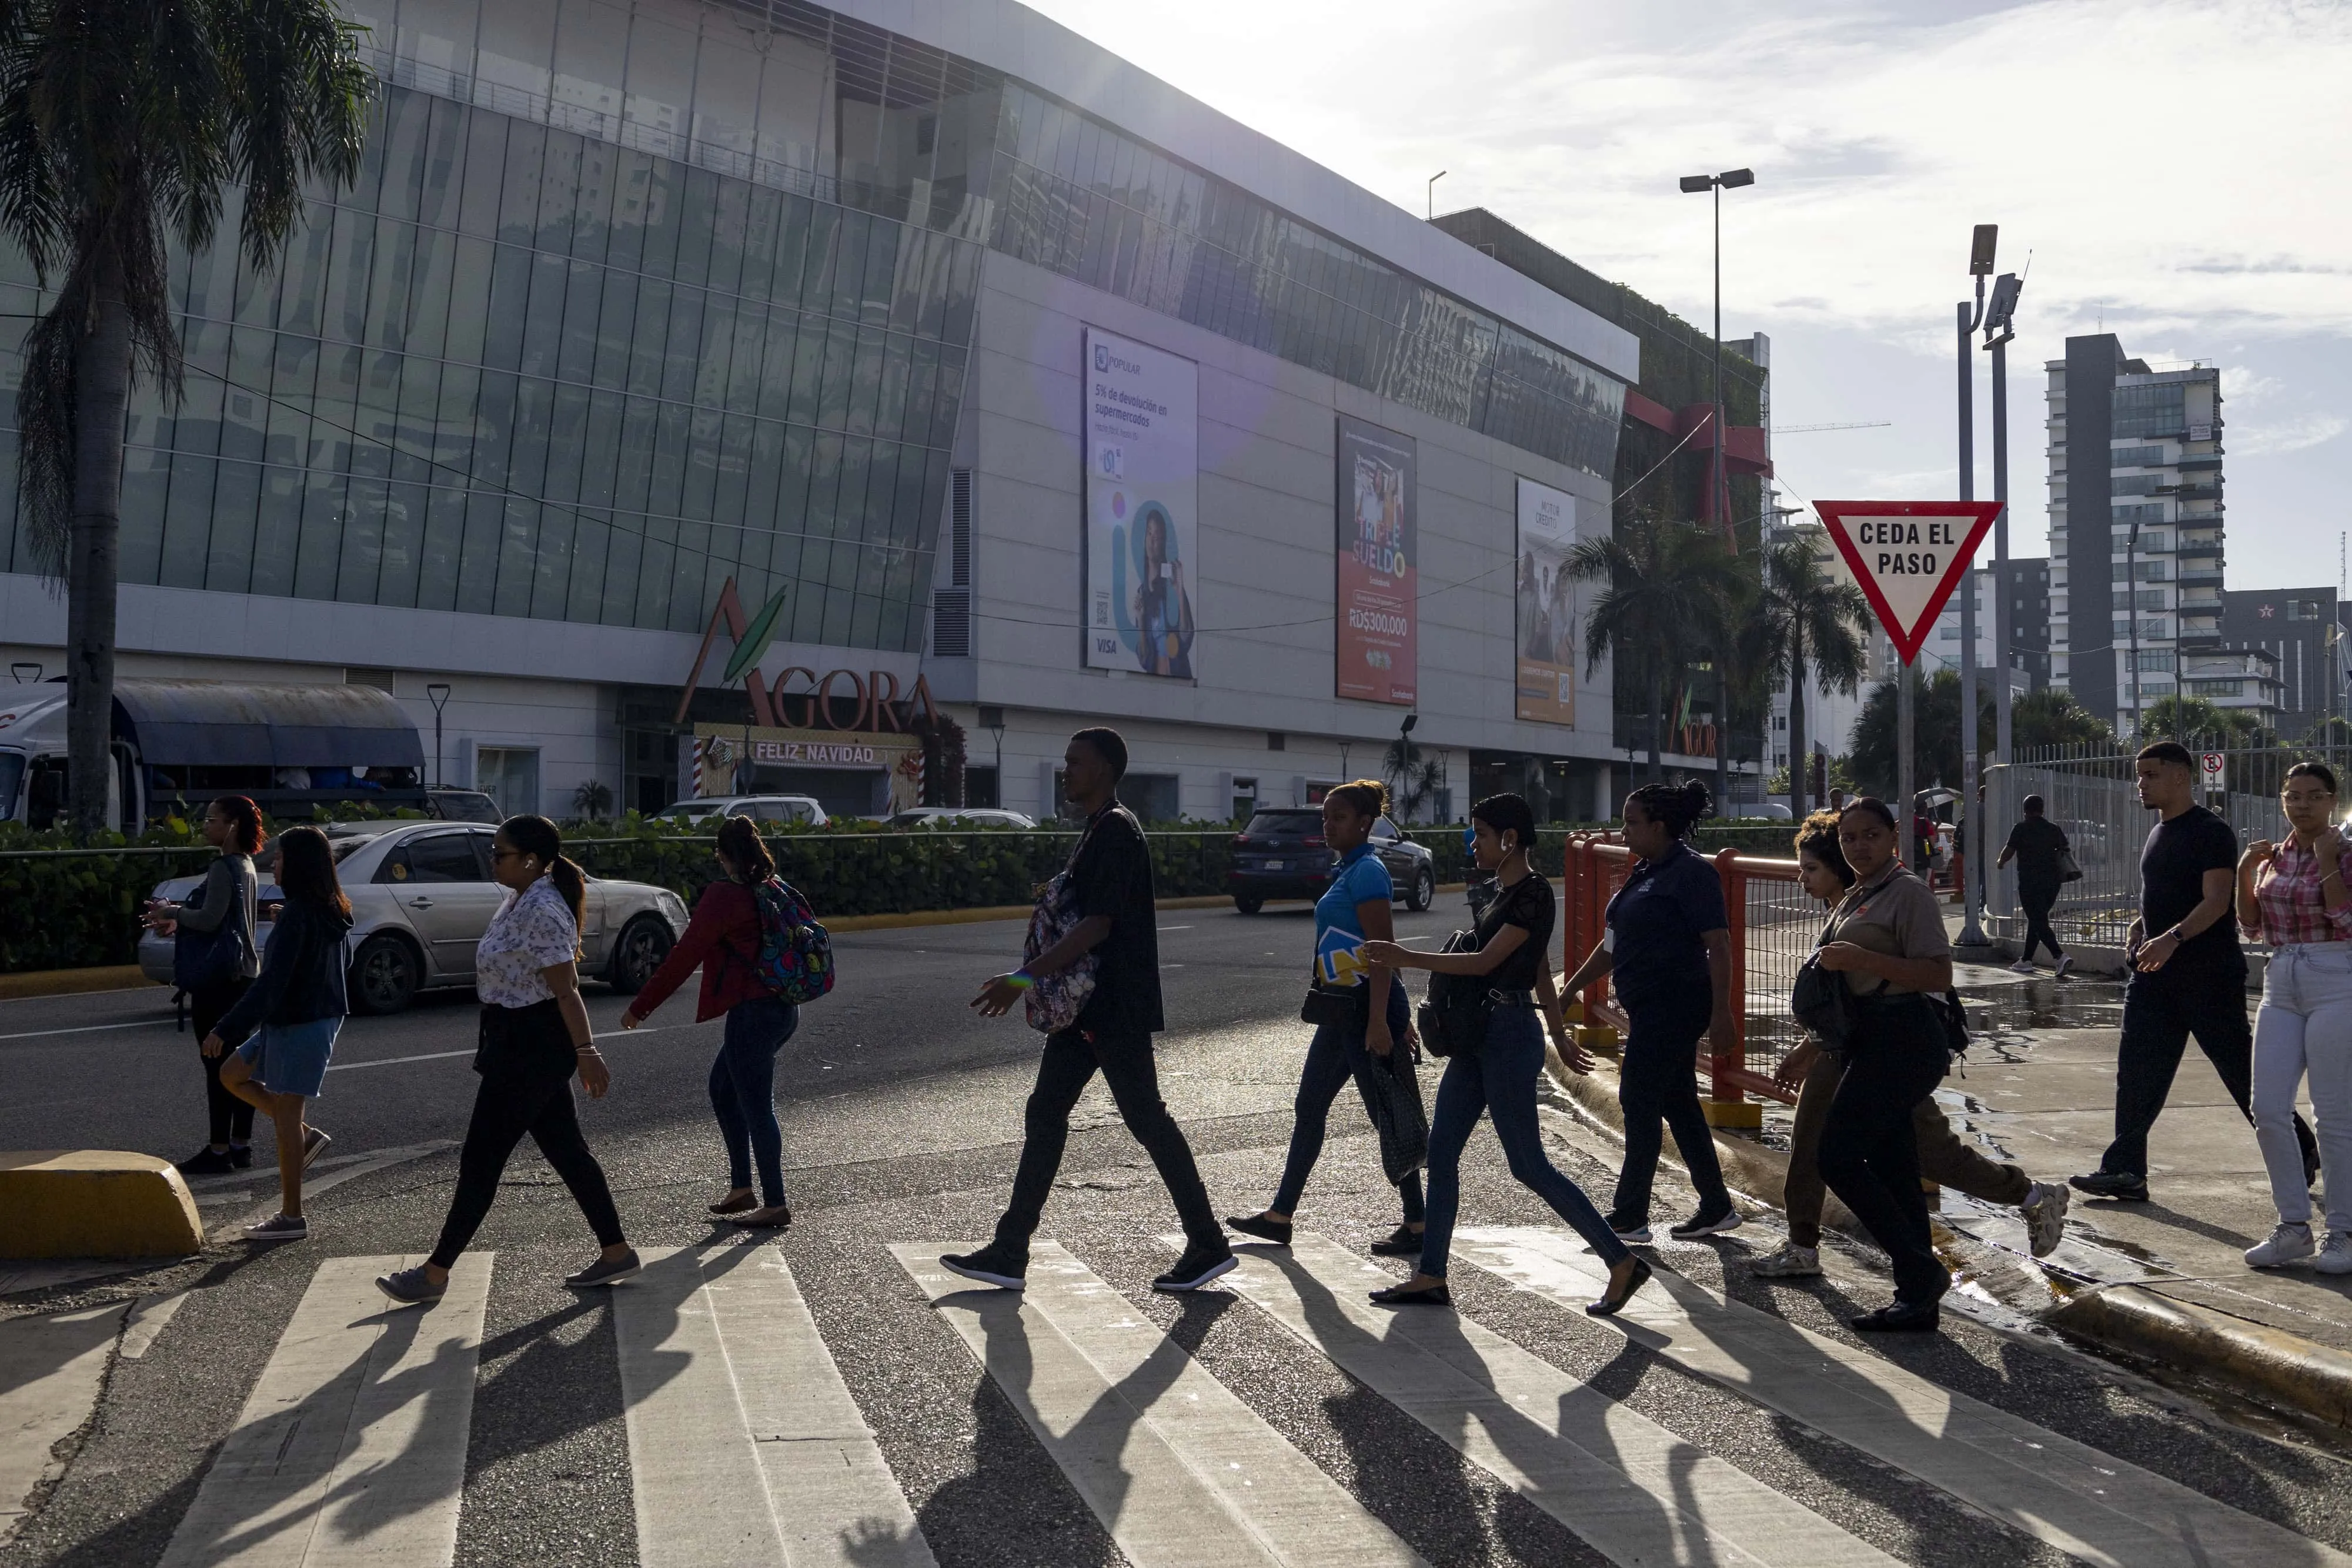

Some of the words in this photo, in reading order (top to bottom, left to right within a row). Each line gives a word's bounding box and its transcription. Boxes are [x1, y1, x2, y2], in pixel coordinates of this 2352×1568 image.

[1108, 356, 1141, 375] POPULAR
[1095, 384, 1106, 398] 5%
[1108, 387, 1117, 401] de
[1119, 391, 1157, 413] devolución
[1158, 405, 1167, 417] en
[1095, 403, 1150, 428] supermercados
[1541, 500, 1560, 517] MOTOR
[1355, 516, 1400, 550] TRIPLE
[1860, 522, 1920, 544] CEDA
[1929, 523, 1954, 544] EL
[1352, 540, 1406, 579] SUELDO
[1878, 553, 1936, 574] PASO
[1349, 608, 1407, 637] RD$300,000
[1097, 638, 1116, 654] VISA
[1669, 679, 1717, 758] AGOR
[756, 743, 799, 760] FELIZ
[806, 745, 873, 763] NAVIDAD
